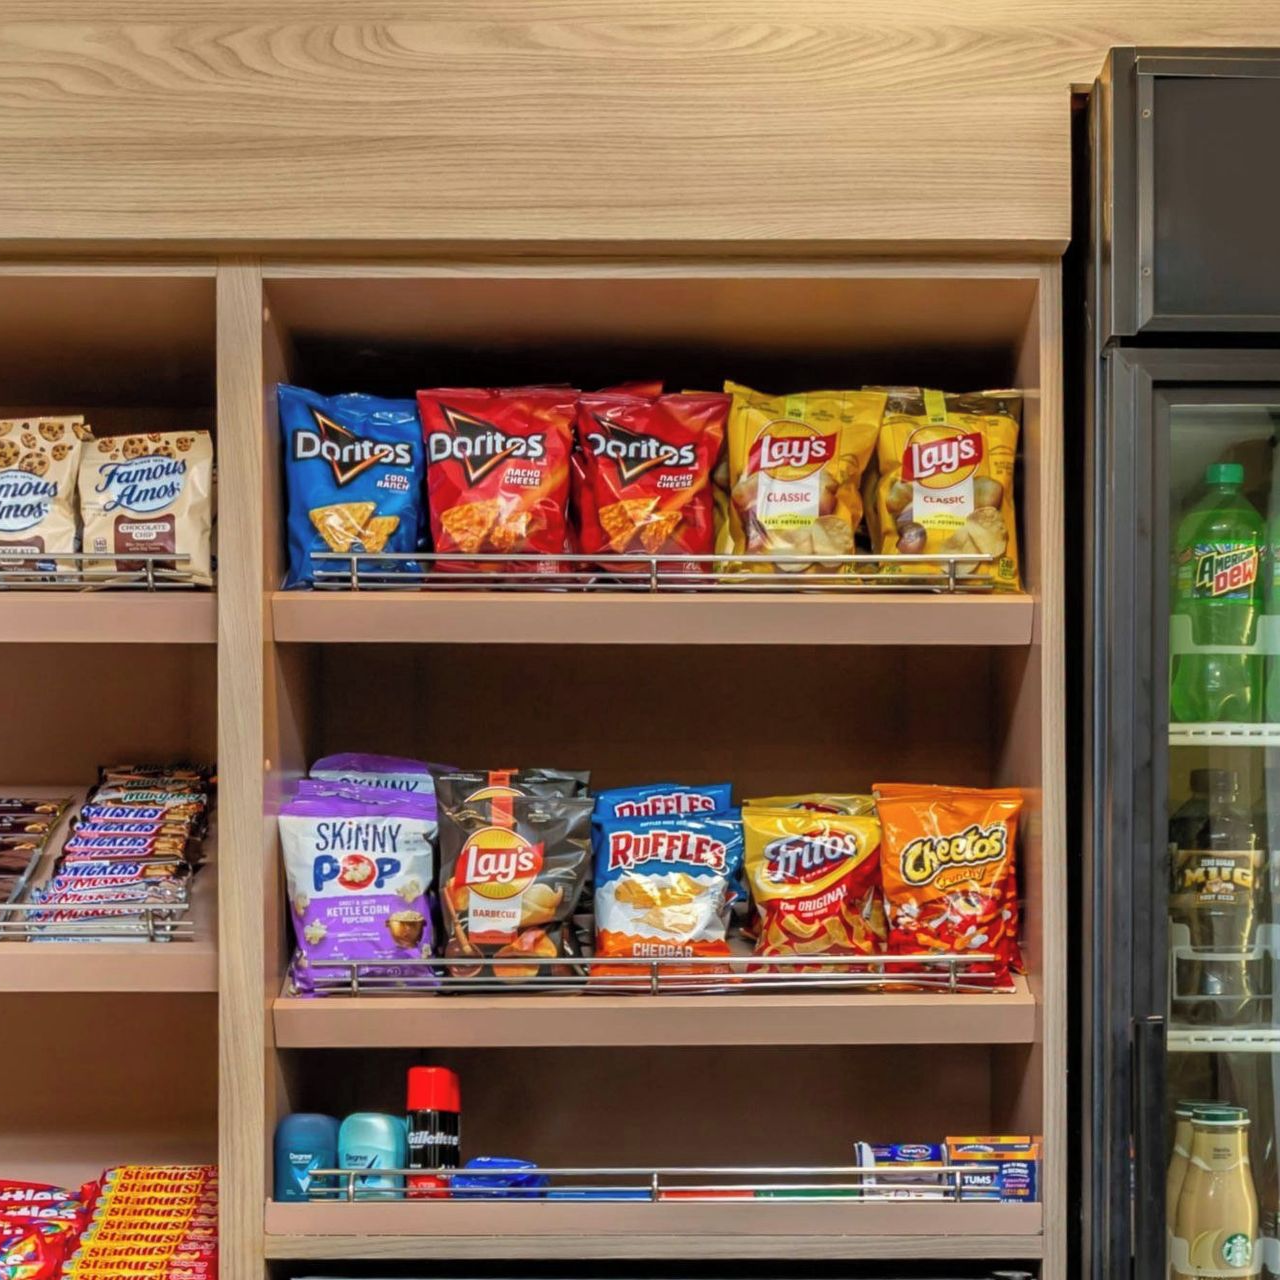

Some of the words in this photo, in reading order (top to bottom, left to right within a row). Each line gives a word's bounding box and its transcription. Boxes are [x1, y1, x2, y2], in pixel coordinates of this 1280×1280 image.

[296, 431, 411, 464] Doritos
[429, 430, 544, 461] Doritos
[760, 434, 827, 467] Lay's
[912, 434, 975, 476] Lay's
[95, 459, 187, 492] Famous
[507, 468, 541, 477] NACHO
[659, 473, 693, 483] NACHO
[384, 474, 408, 484] COOL
[504, 476, 540, 486] CHEESE
[656, 478, 693, 488] CHEESE
[377, 481, 410, 491] RANCH
[103, 483, 176, 511] Amos
[766, 493, 810, 503] CLASSIC
[922, 495, 965, 505] CLASSIC
[120, 524, 168, 533] CHOCOLATE
[316, 821, 402, 852] SKINNY
[609, 830, 726, 872] RUFFLES
[904, 827, 1007, 883] Cheetos
[469, 843, 535, 882] Lay's
[765, 832, 858, 883] Fritos
[59, 862, 140, 876] SNICKERS
[934, 867, 985, 891] Crunchy
[327, 906, 361, 917] KETTLE
[362, 905, 389, 914] CORN
[472, 909, 517, 918] BARBECUE
[633, 942, 693, 958] CHEDDAR
[408, 1131, 459, 1147] Gillette
[123, 1170, 203, 1181] Starburst
[963, 1174, 992, 1185] TUMS
[118, 1183, 203, 1194] Starburst
[112, 1195, 196, 1206] Starburst
[108, 1207, 192, 1218] Starburst
